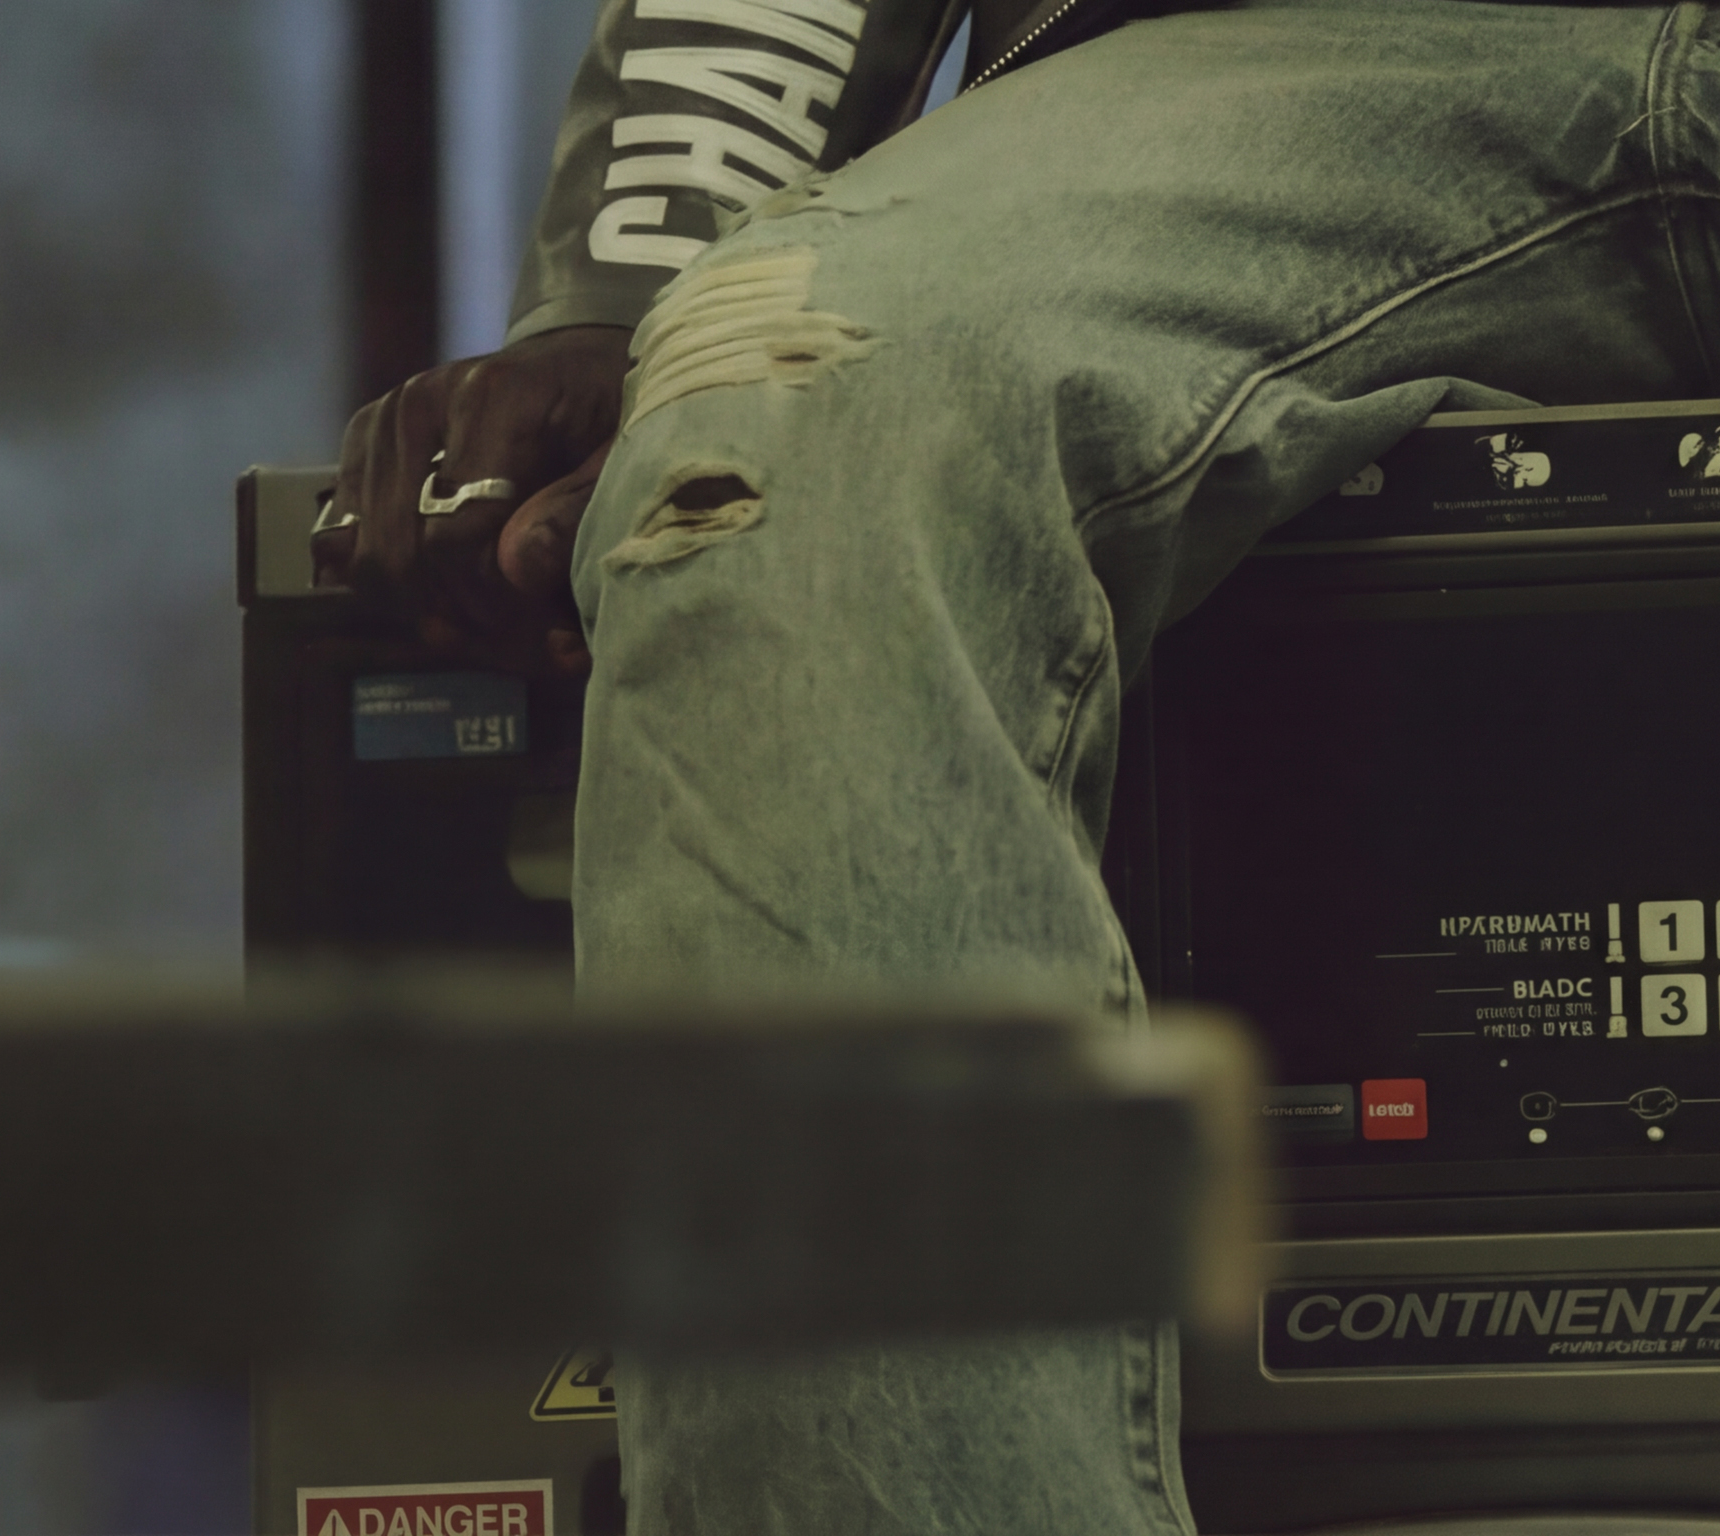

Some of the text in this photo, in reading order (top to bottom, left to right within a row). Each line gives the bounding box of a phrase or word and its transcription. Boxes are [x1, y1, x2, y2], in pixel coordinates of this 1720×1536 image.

[1658, 912, 1679, 952] 1
[1659, 985, 1689, 1027] 3
[358, 1503, 529, 1536] DANGER
